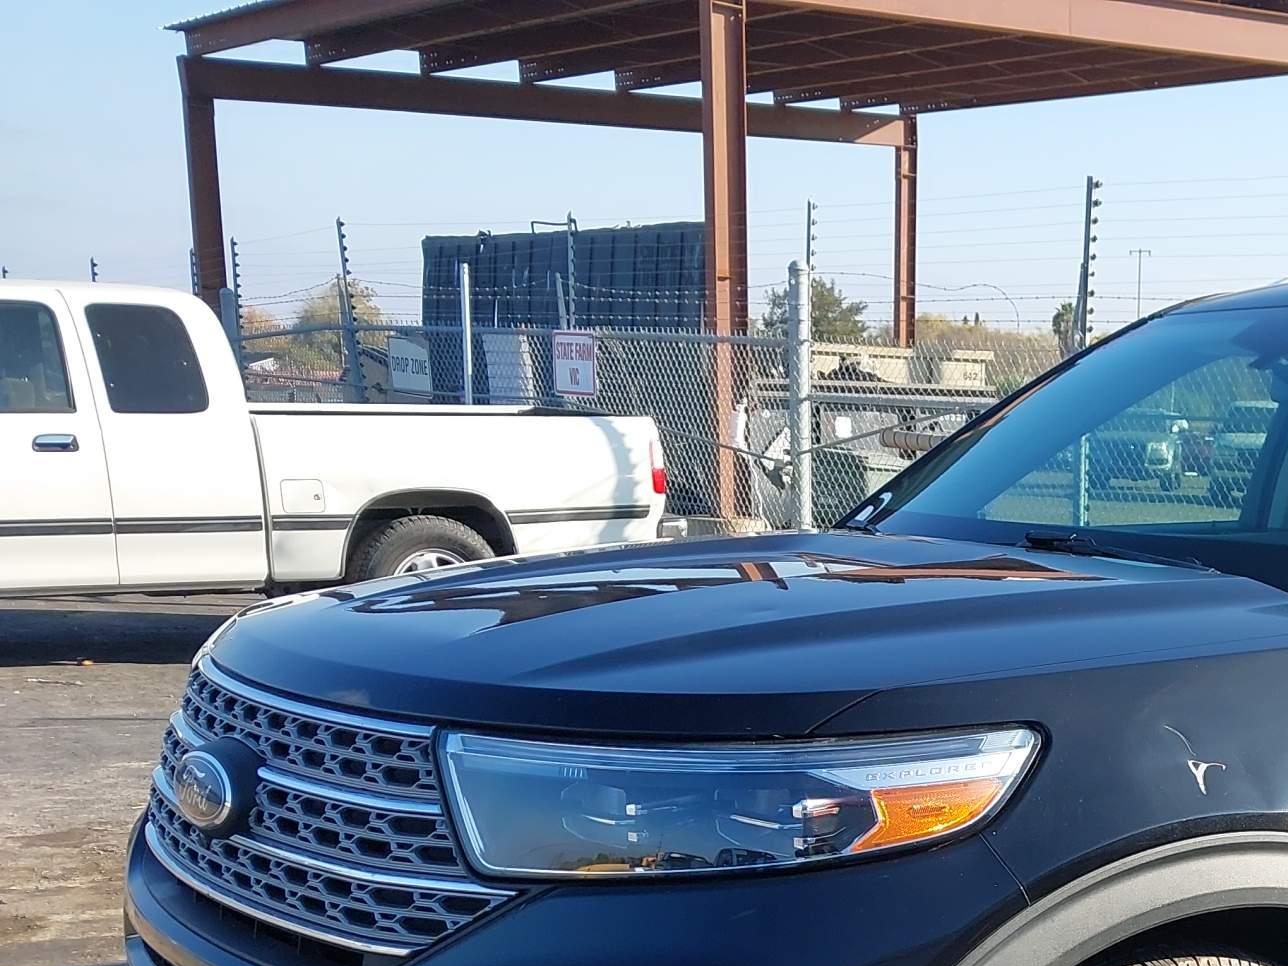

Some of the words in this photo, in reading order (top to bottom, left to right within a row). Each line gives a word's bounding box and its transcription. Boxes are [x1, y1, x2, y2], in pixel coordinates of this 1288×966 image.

[556, 341, 574, 360] STATE
[575, 342, 592, 361] FARM
[391, 355, 409, 373] DROP
[410, 357, 428, 376] ZONE
[183, 764, 212, 811] Ford
